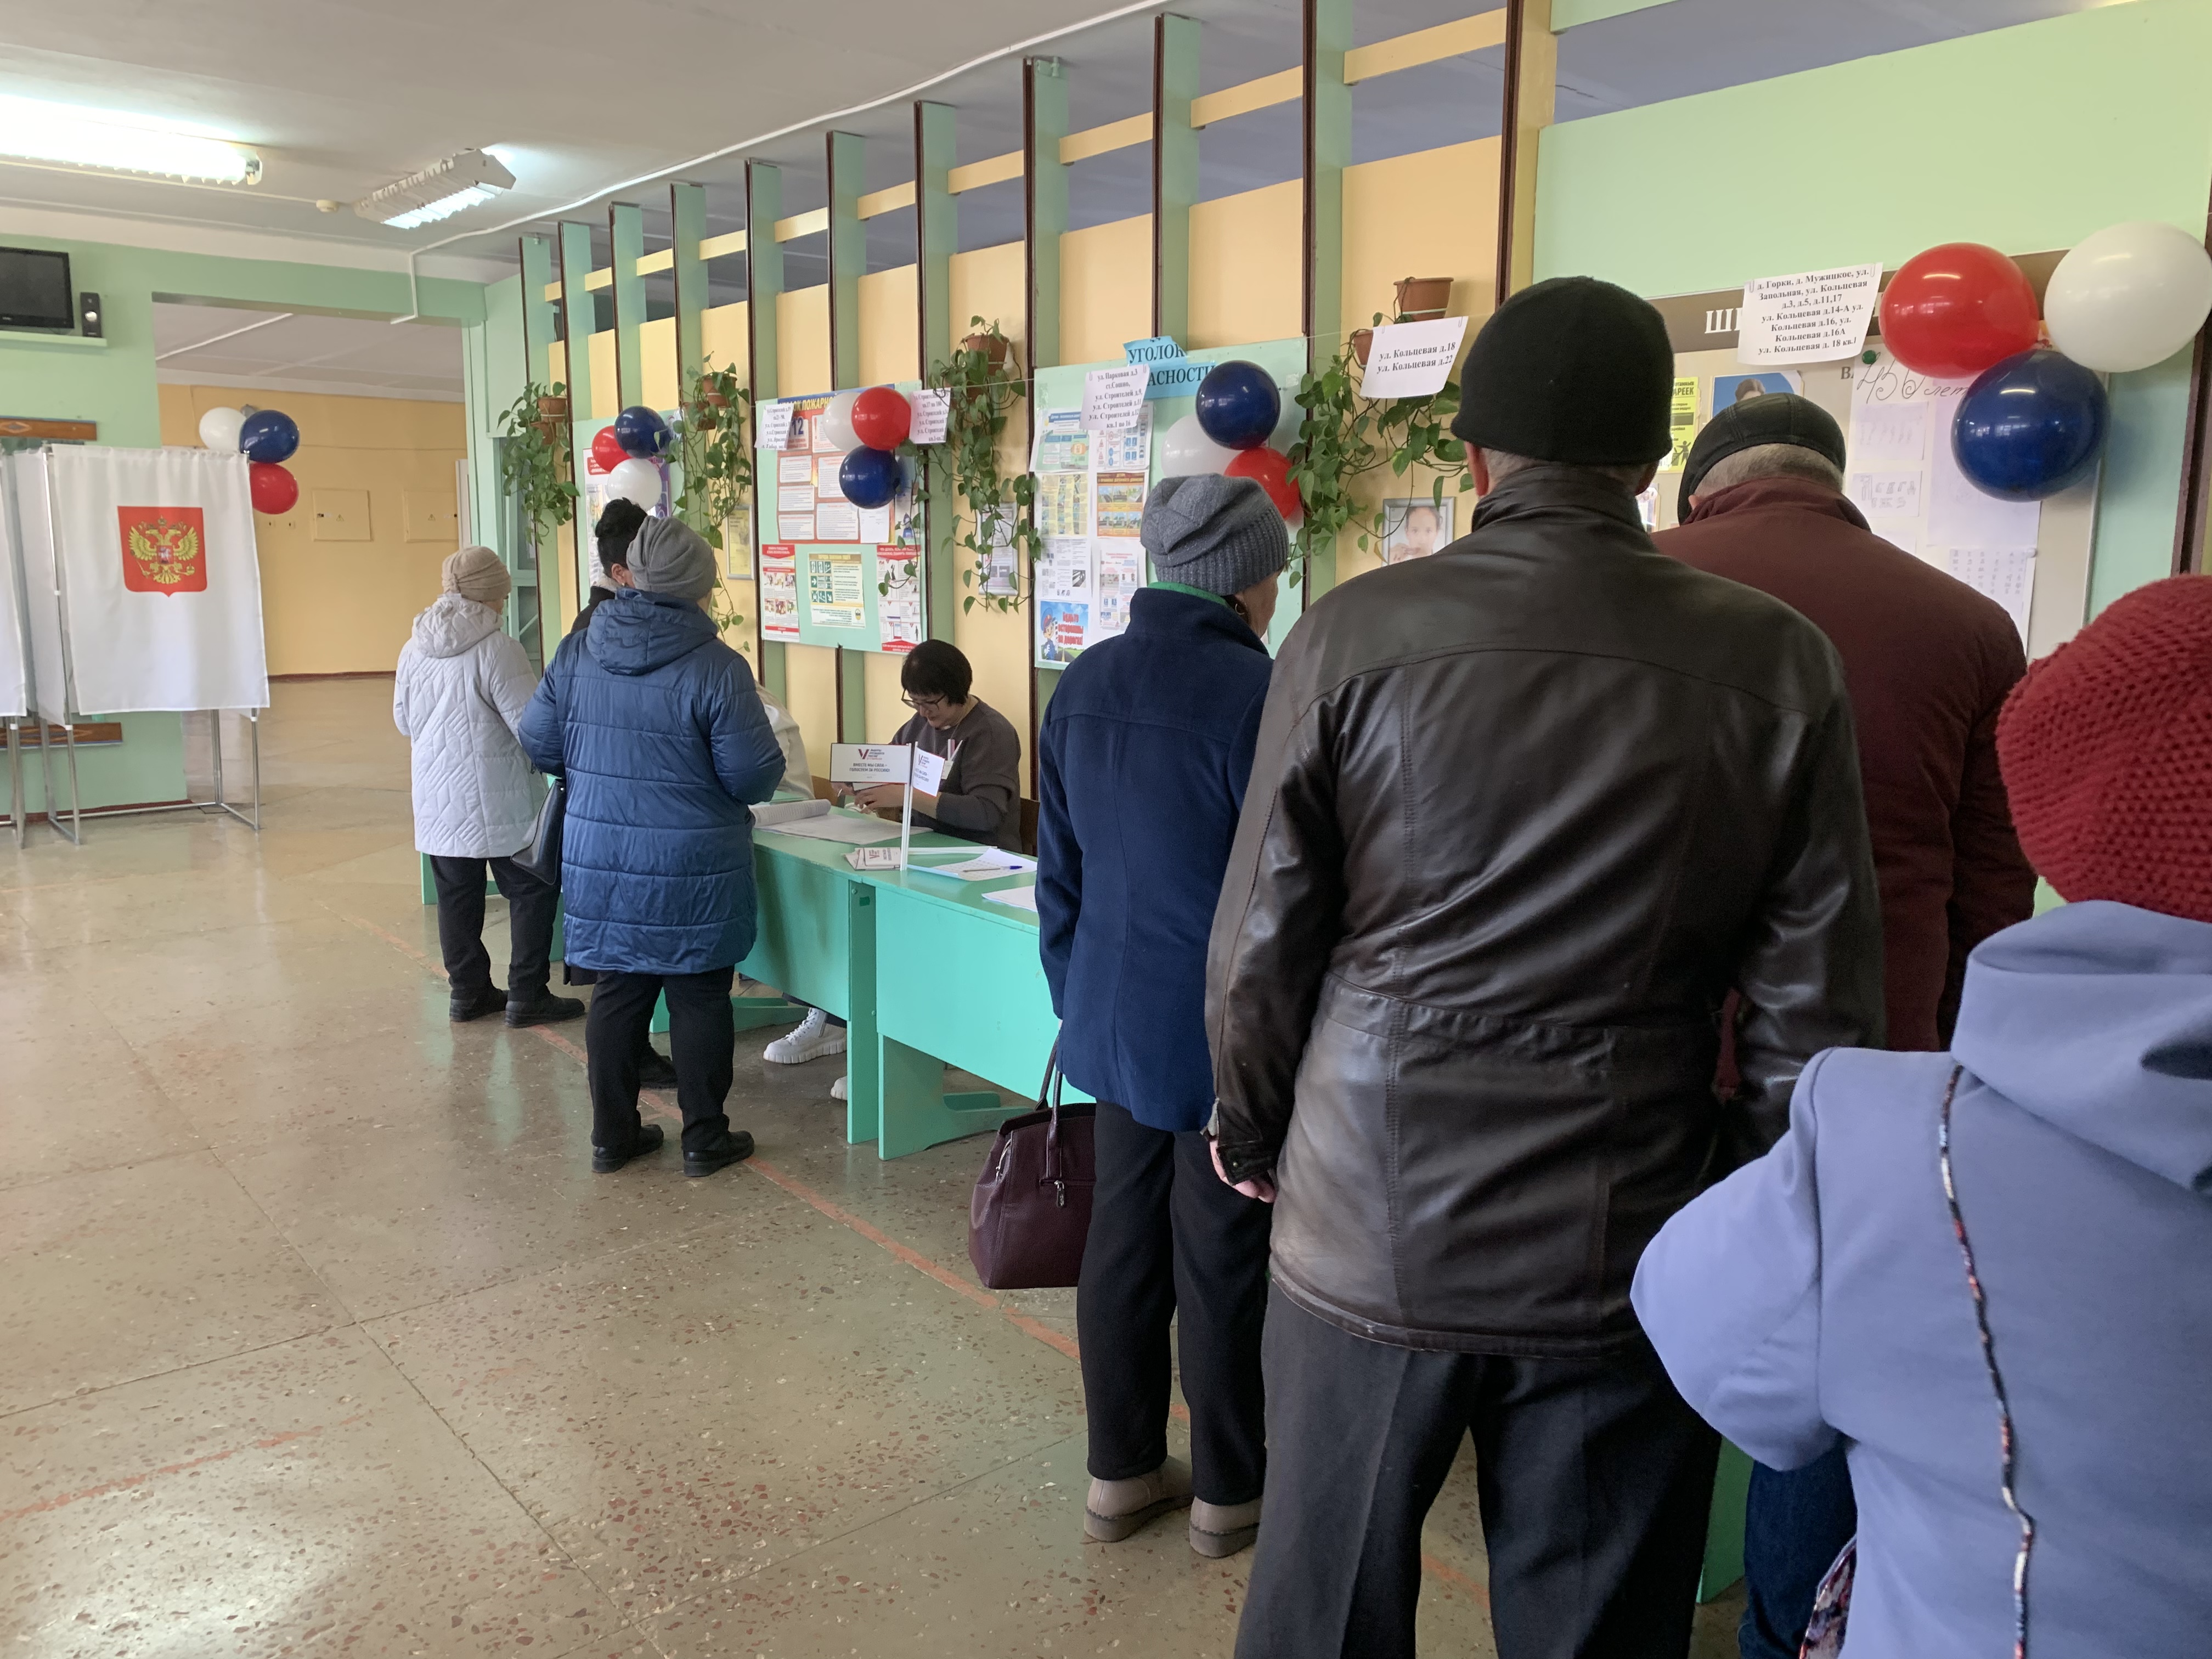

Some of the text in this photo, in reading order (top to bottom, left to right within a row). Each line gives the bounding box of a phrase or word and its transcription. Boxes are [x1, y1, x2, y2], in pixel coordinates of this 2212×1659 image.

[1766, 279, 1794, 289] Горки,
[1856, 268, 1869, 278] ул.
[1759, 280, 1867, 301] Запольная, ул. Кольцевая
[1781, 300, 1796, 309] д.3,
[1797, 297, 1812, 307] д.5,
[1761, 314, 1774, 324] ул.
[1776, 308, 1821, 321] Кольцевая
[1851, 303, 1864, 314] ул.
[1771, 320, 1816, 331] Кольцевая
[1839, 317, 1852, 325] ул.
[1775, 330, 1821, 342] Кольцевая
[1128, 344, 1185, 364] УГОЛОК
[1379, 341, 1456, 362] ул. Кольцевая д.18
[1758, 346, 1771, 356] ул.
[1774, 341, 1820, 353] Кольцевая
[1832, 339, 1841, 347] 18
[1376, 354, 1453, 374] ул. Кольцевая д.22
[1105, 371, 1129, 381] Парковая
[1104, 390, 1133, 400] Строителей
[1092, 404, 1102, 412] ул.
[1103, 400, 1132, 410] Строителей
[1100, 409, 1130, 421] Строителей
